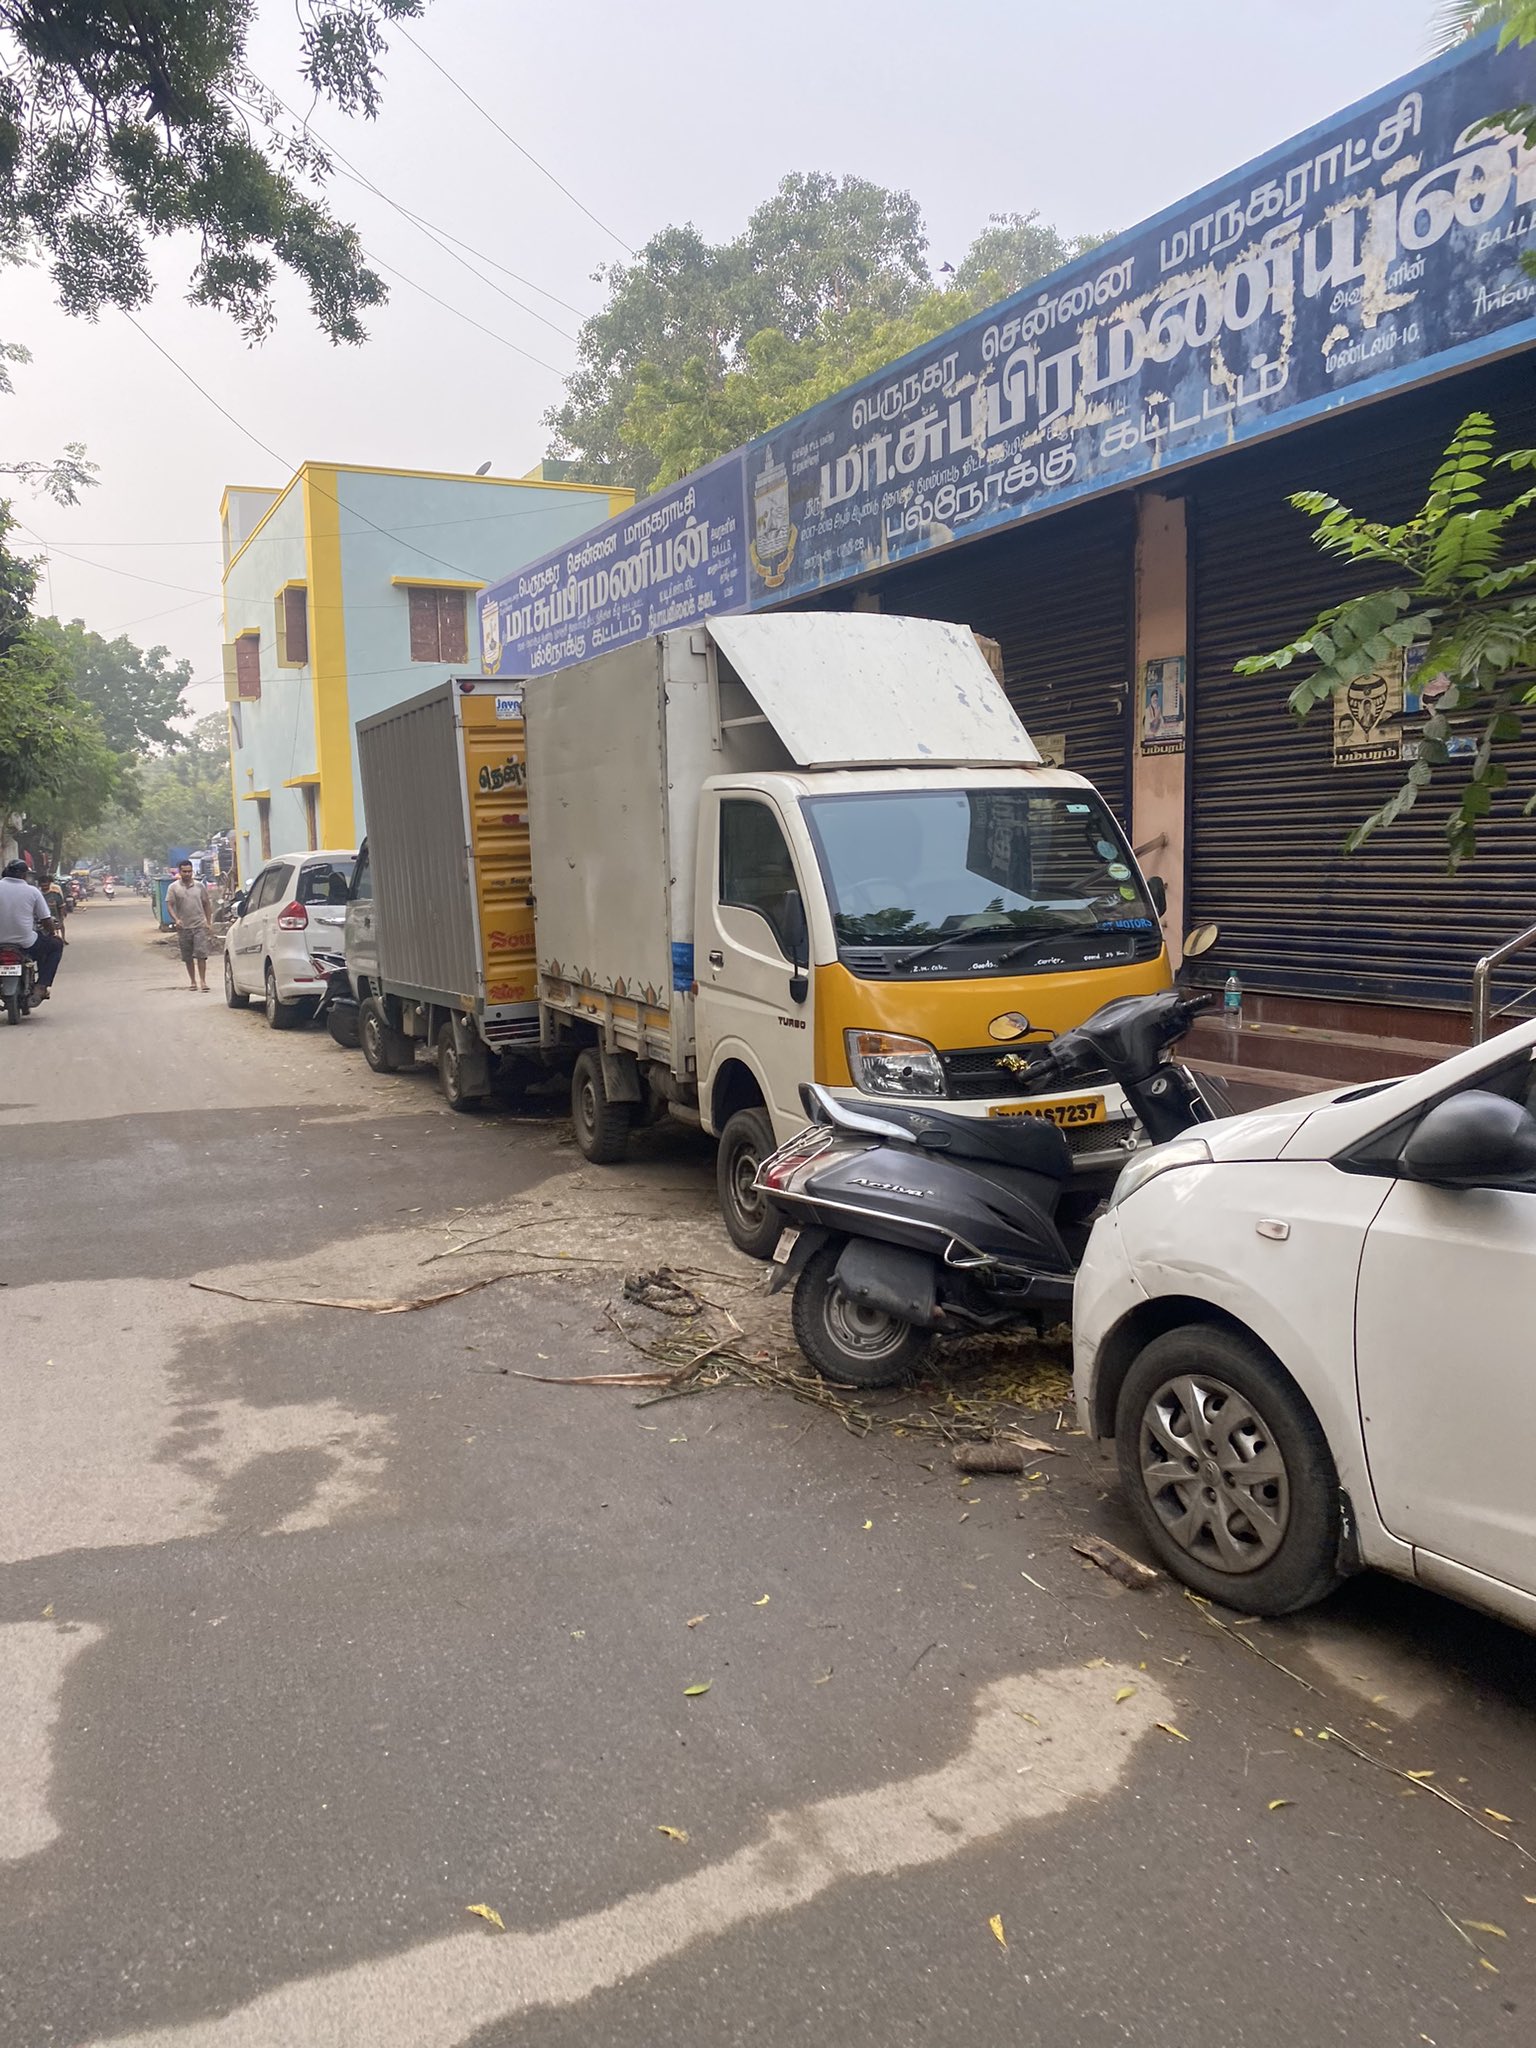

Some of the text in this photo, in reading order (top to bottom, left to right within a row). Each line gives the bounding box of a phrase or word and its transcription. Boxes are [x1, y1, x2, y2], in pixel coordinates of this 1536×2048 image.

[852, 92, 1422, 430] பெருநகர சென்னை மாநகராட்சி
[887, 353, 1289, 538] பல்நோக்கு கட்டடம்
[518, 486, 696, 598] பெருநகர சென்னை மாநகராட்சி
[531, 633, 586, 668] பல்நோக்கு
[592, 609, 642, 647] கட்டடம்
[1116, 918, 1153, 929] MOTORS
[778, 1016, 806, 1030] TURBO
